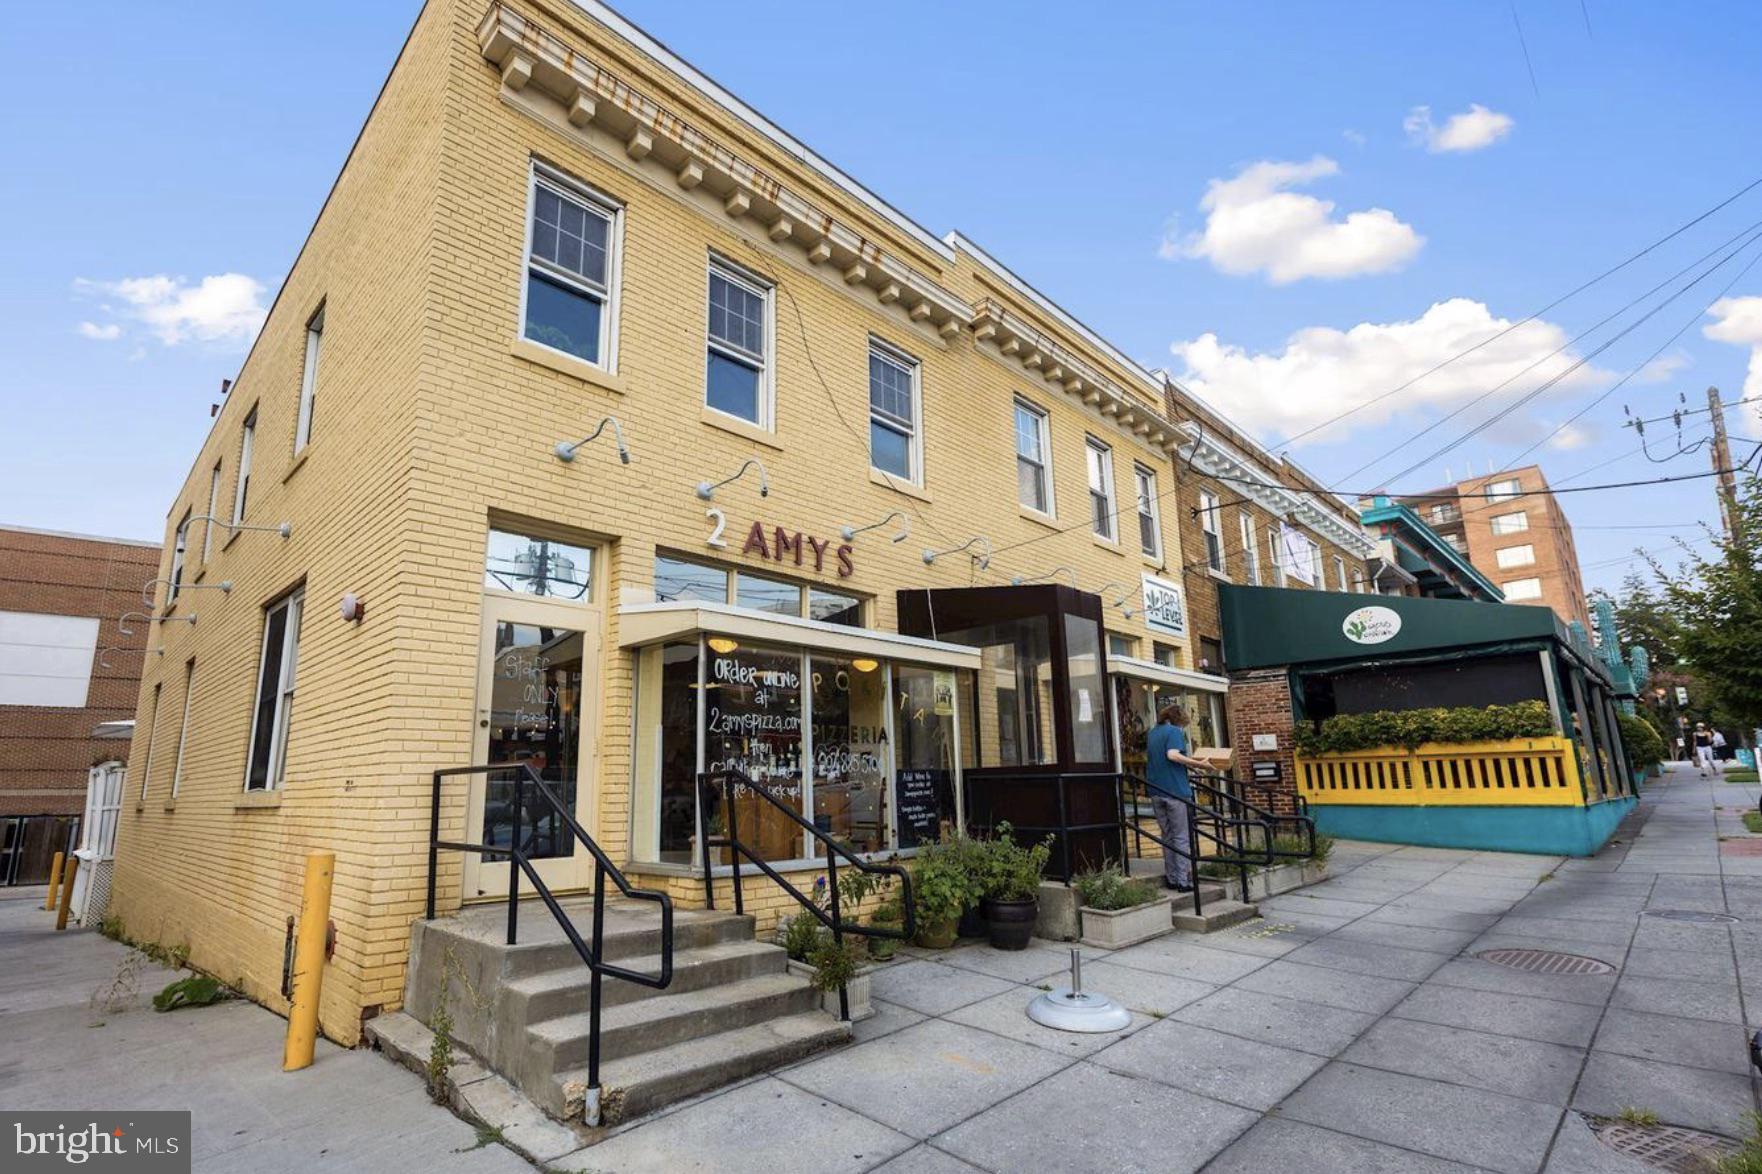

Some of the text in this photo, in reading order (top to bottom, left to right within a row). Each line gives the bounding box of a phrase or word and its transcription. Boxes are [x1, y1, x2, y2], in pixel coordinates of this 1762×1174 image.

[706, 508, 854, 577] 2 AMYS
[811, 725, 889, 745] PIZZERIA
